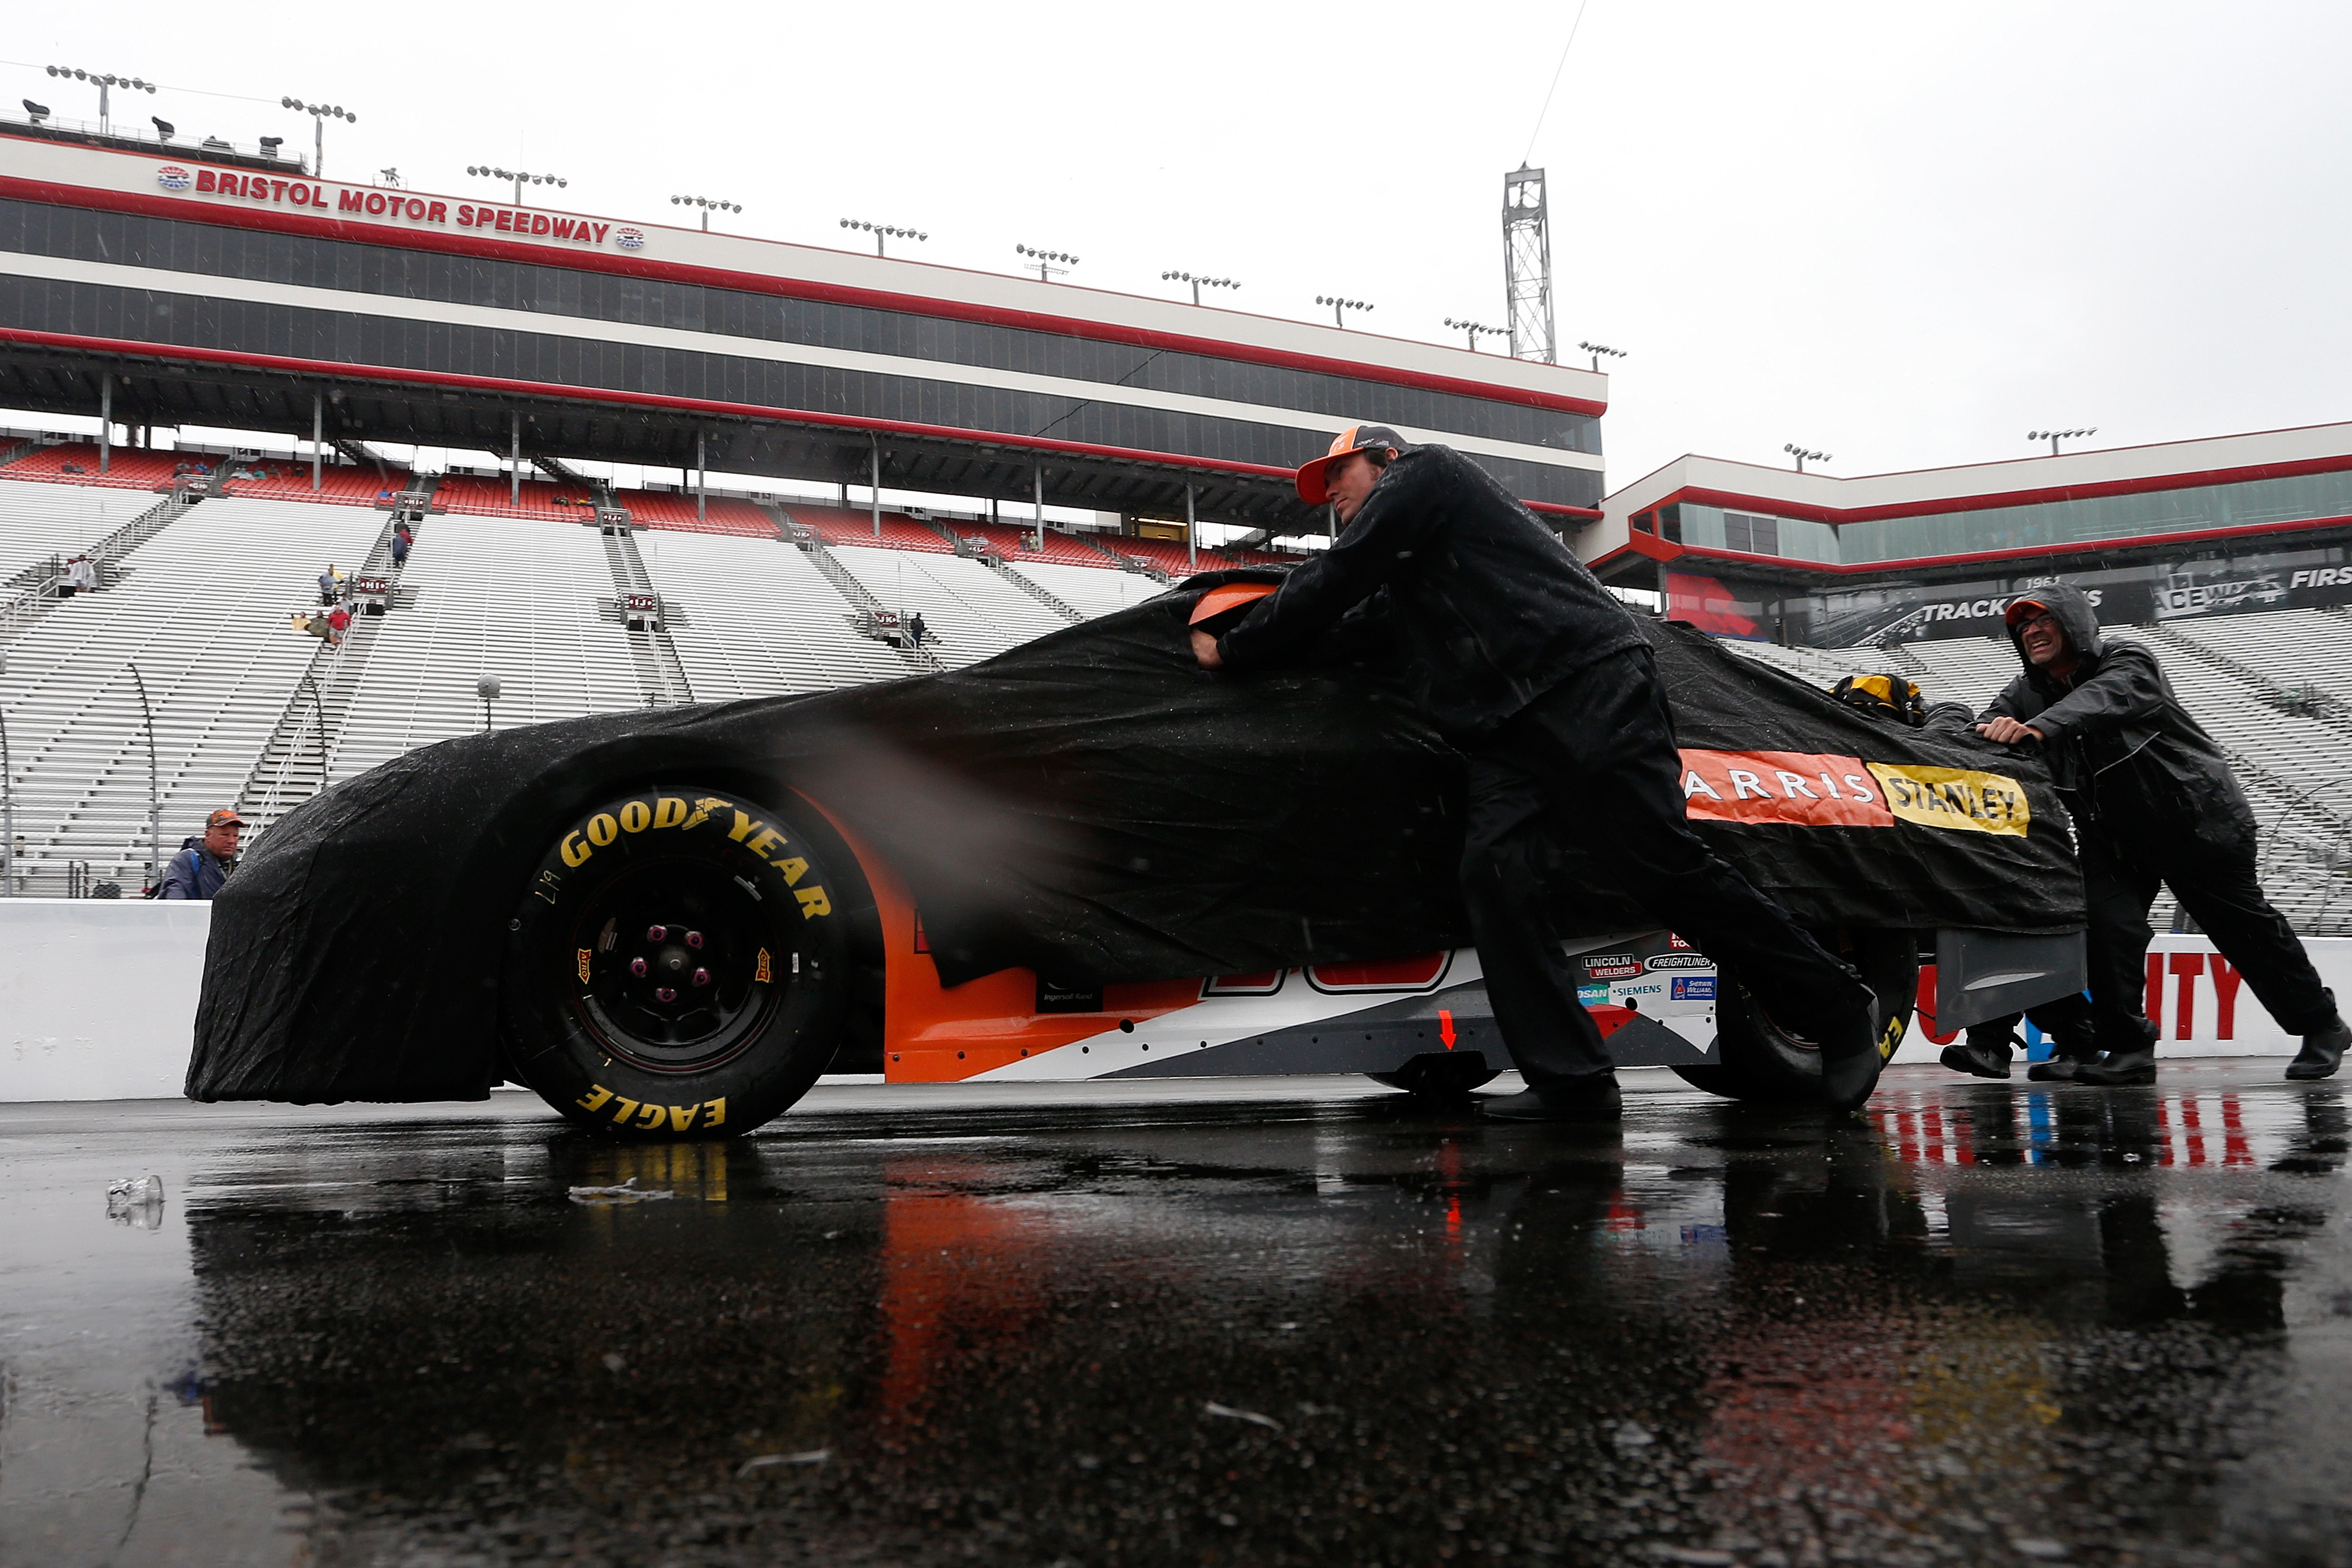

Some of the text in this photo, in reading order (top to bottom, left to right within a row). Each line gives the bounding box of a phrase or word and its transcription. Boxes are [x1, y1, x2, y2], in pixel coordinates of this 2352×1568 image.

[195, 169, 611, 244] BRISTOL MOTOR SPEEDWAY
[365, 581, 380, 590] HI
[1921, 597, 2007, 622] TRACK
[1684, 770, 2015, 821] ARRIS STANLEY
[1585, 956, 1631, 968] LINCOLN
[1595, 966, 1636, 976] WELDERS
[1044, 993, 1074, 1002] Ingersoll
[1617, 985, 1662, 997] SIEMENS
[2145, 952, 2243, 1041] ITY
[575, 1084, 727, 1132] EAGLE
